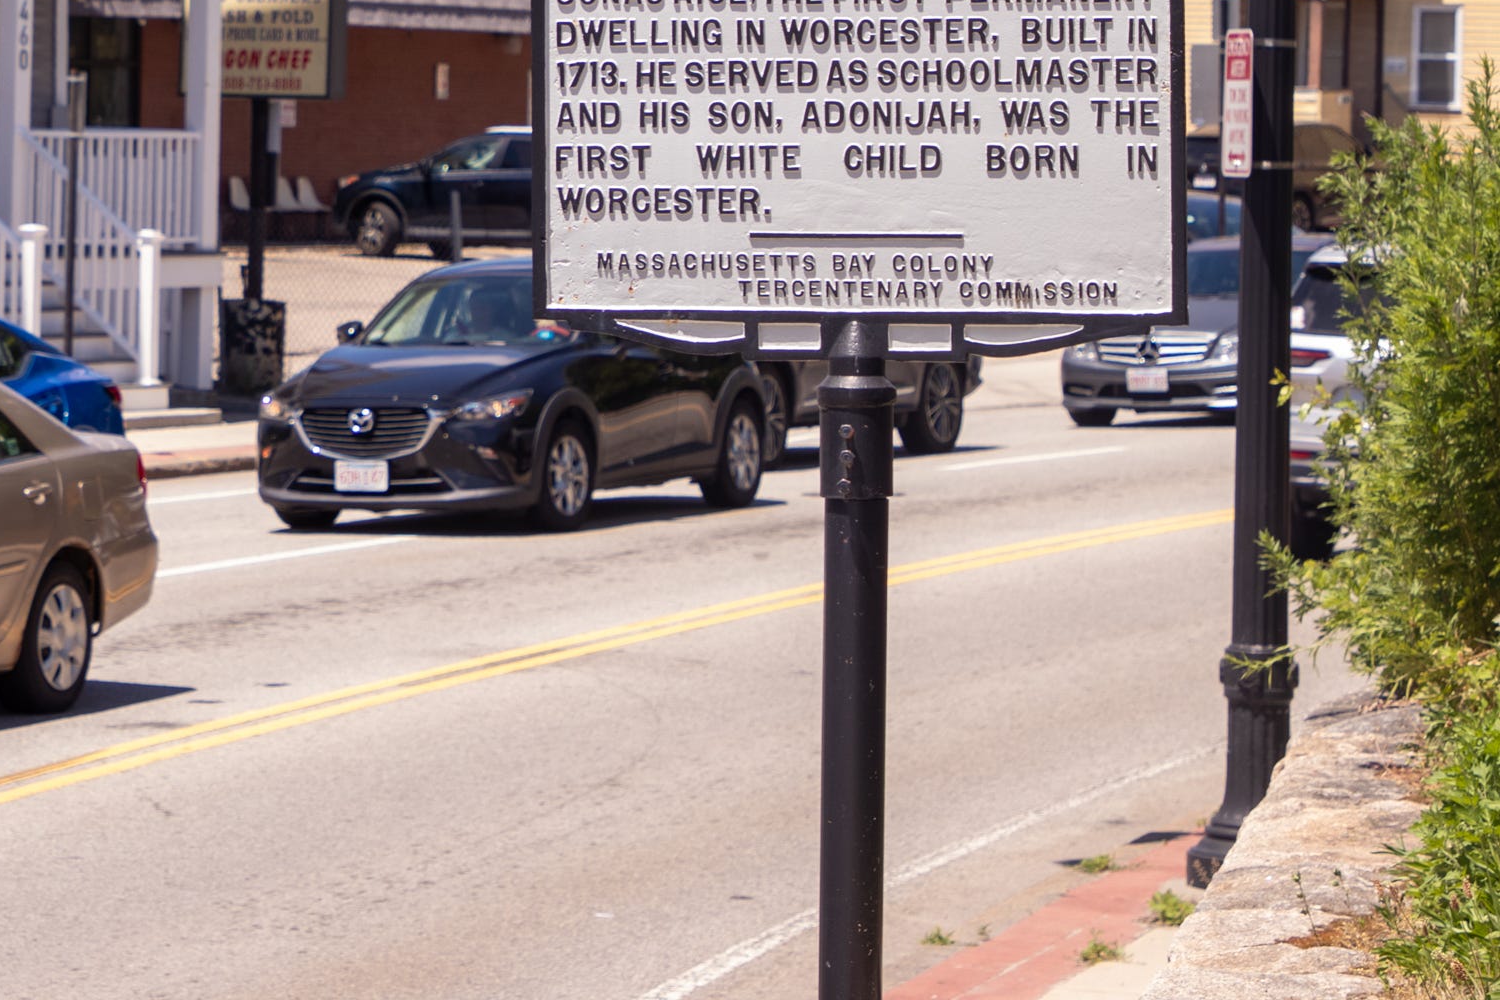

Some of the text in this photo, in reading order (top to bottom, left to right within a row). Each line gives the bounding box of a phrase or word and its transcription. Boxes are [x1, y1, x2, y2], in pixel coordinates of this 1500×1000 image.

[270, 10, 315, 24] FOLD
[19, 0, 29, 71] 460
[556, 18, 1157, 48] DWELLING IN WORCESTER, BUILT IN
[224, 49, 314, 70] GON CHEF
[557, 58, 1157, 88] 1713. HE SERVED AS SCHOOLMASTER
[557, 100, 1158, 129] AND HIS SON, ADONIJAH, WAS THE
[555, 145, 1157, 172] FIRST WHITE CHILD BORN IN
[557, 187, 770, 215] WORCESTER.
[597, 252, 992, 273] MASSACHUSETTS BAY COLONY
[738, 280, 1117, 301] TERCENTENARY COMMISSION
